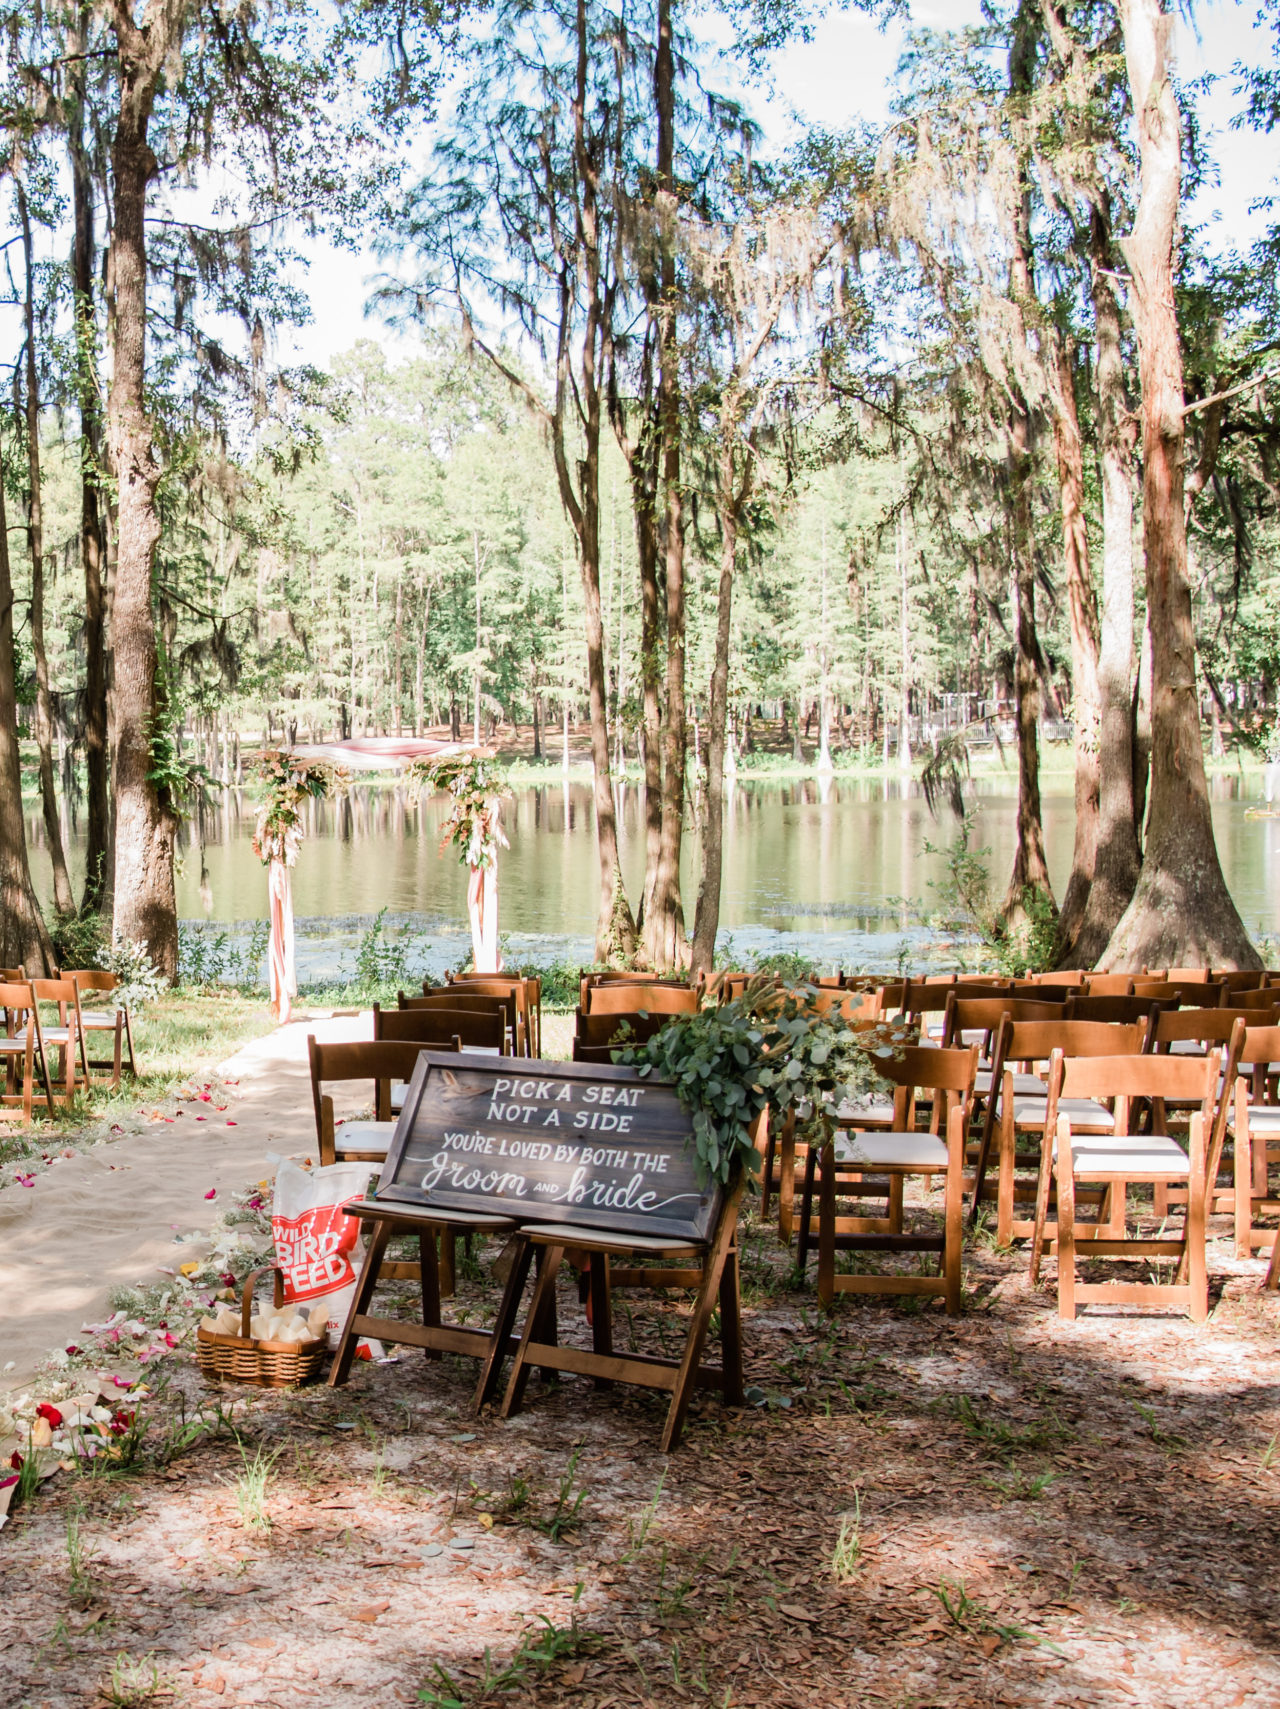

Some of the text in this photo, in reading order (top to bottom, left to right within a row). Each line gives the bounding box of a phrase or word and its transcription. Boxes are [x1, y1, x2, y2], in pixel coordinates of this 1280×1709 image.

[491, 1078, 645, 1107] PICK A SEAT
[487, 1102, 634, 1133] NOT A SIDE
[442, 1130, 670, 1173] YOU'RE LOVED BY BOTH THE
[406, 1151, 702, 1212] groom AND bride
[275, 1231, 342, 1268] BIRD
